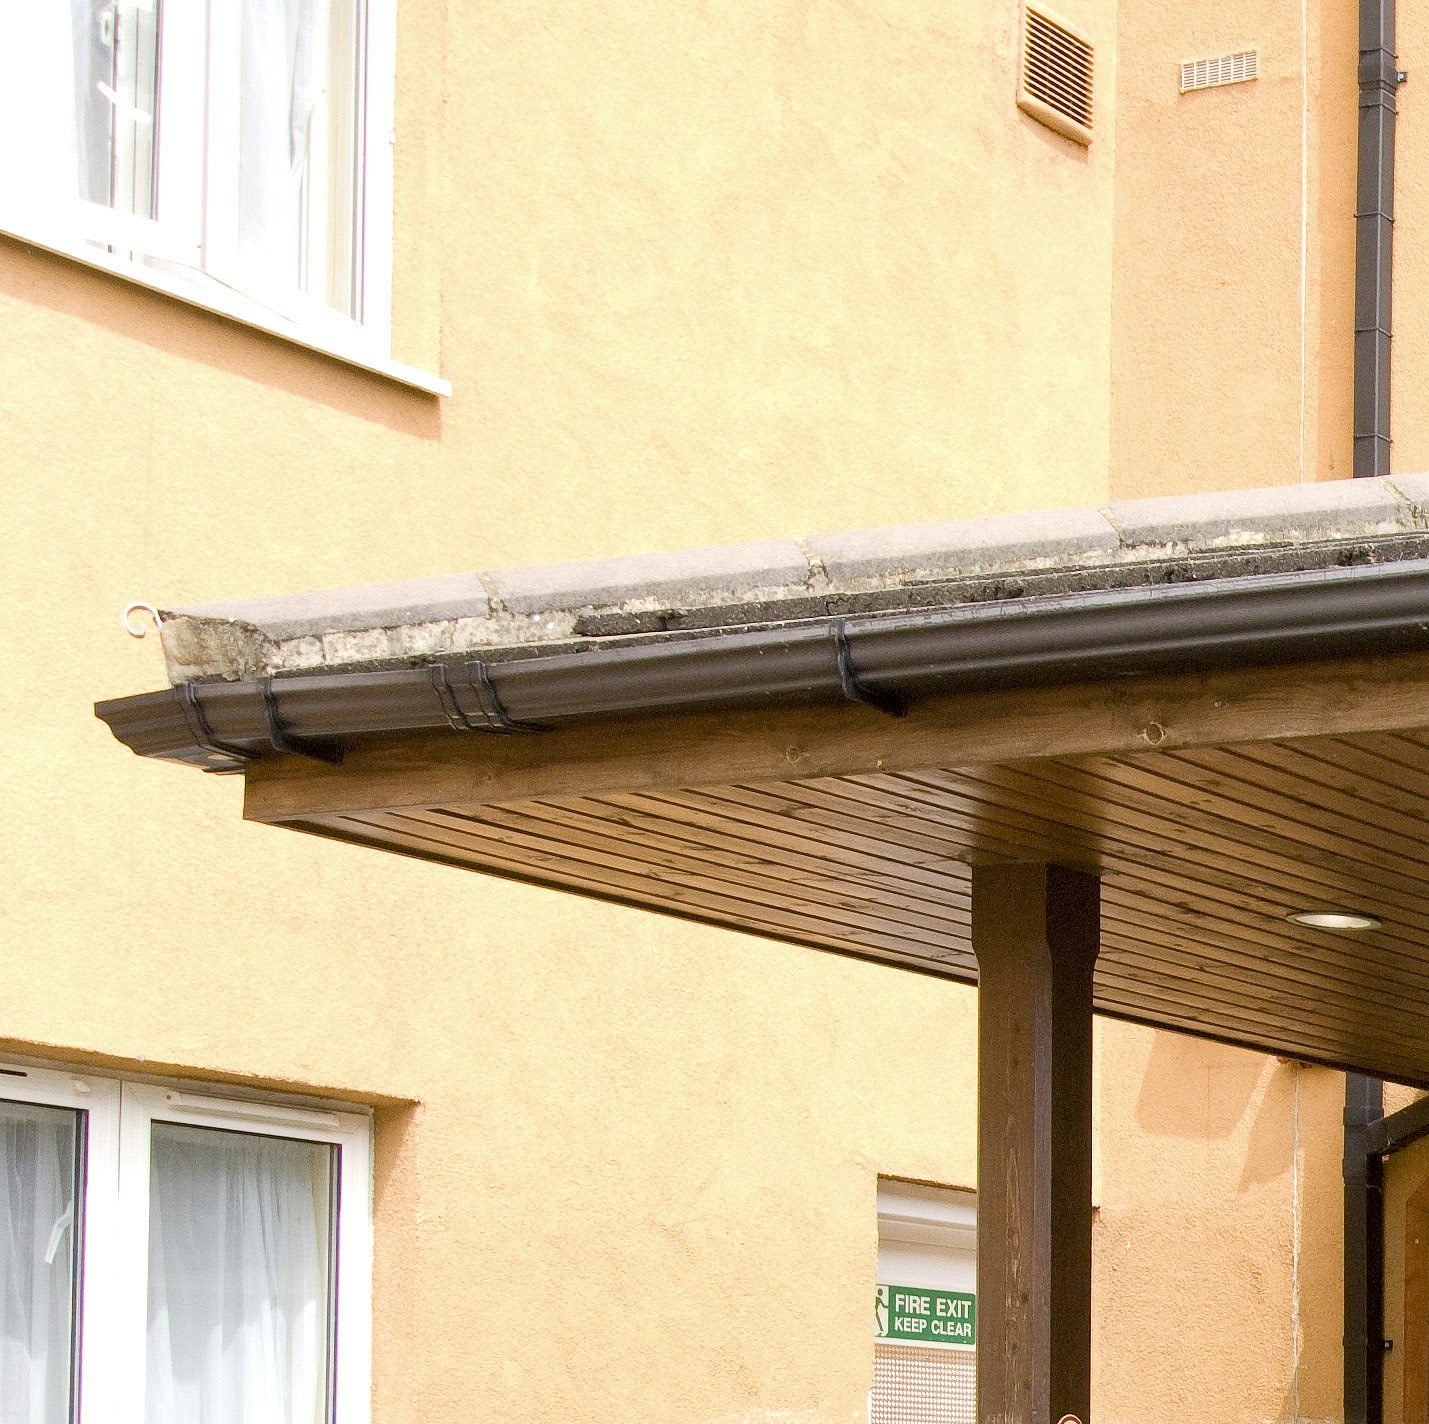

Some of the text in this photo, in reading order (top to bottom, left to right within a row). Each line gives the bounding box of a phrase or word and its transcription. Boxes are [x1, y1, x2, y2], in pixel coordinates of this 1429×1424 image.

[895, 1293, 972, 1319] FIRE EXIT
[894, 1317, 972, 1338] KEEP CLEAR
